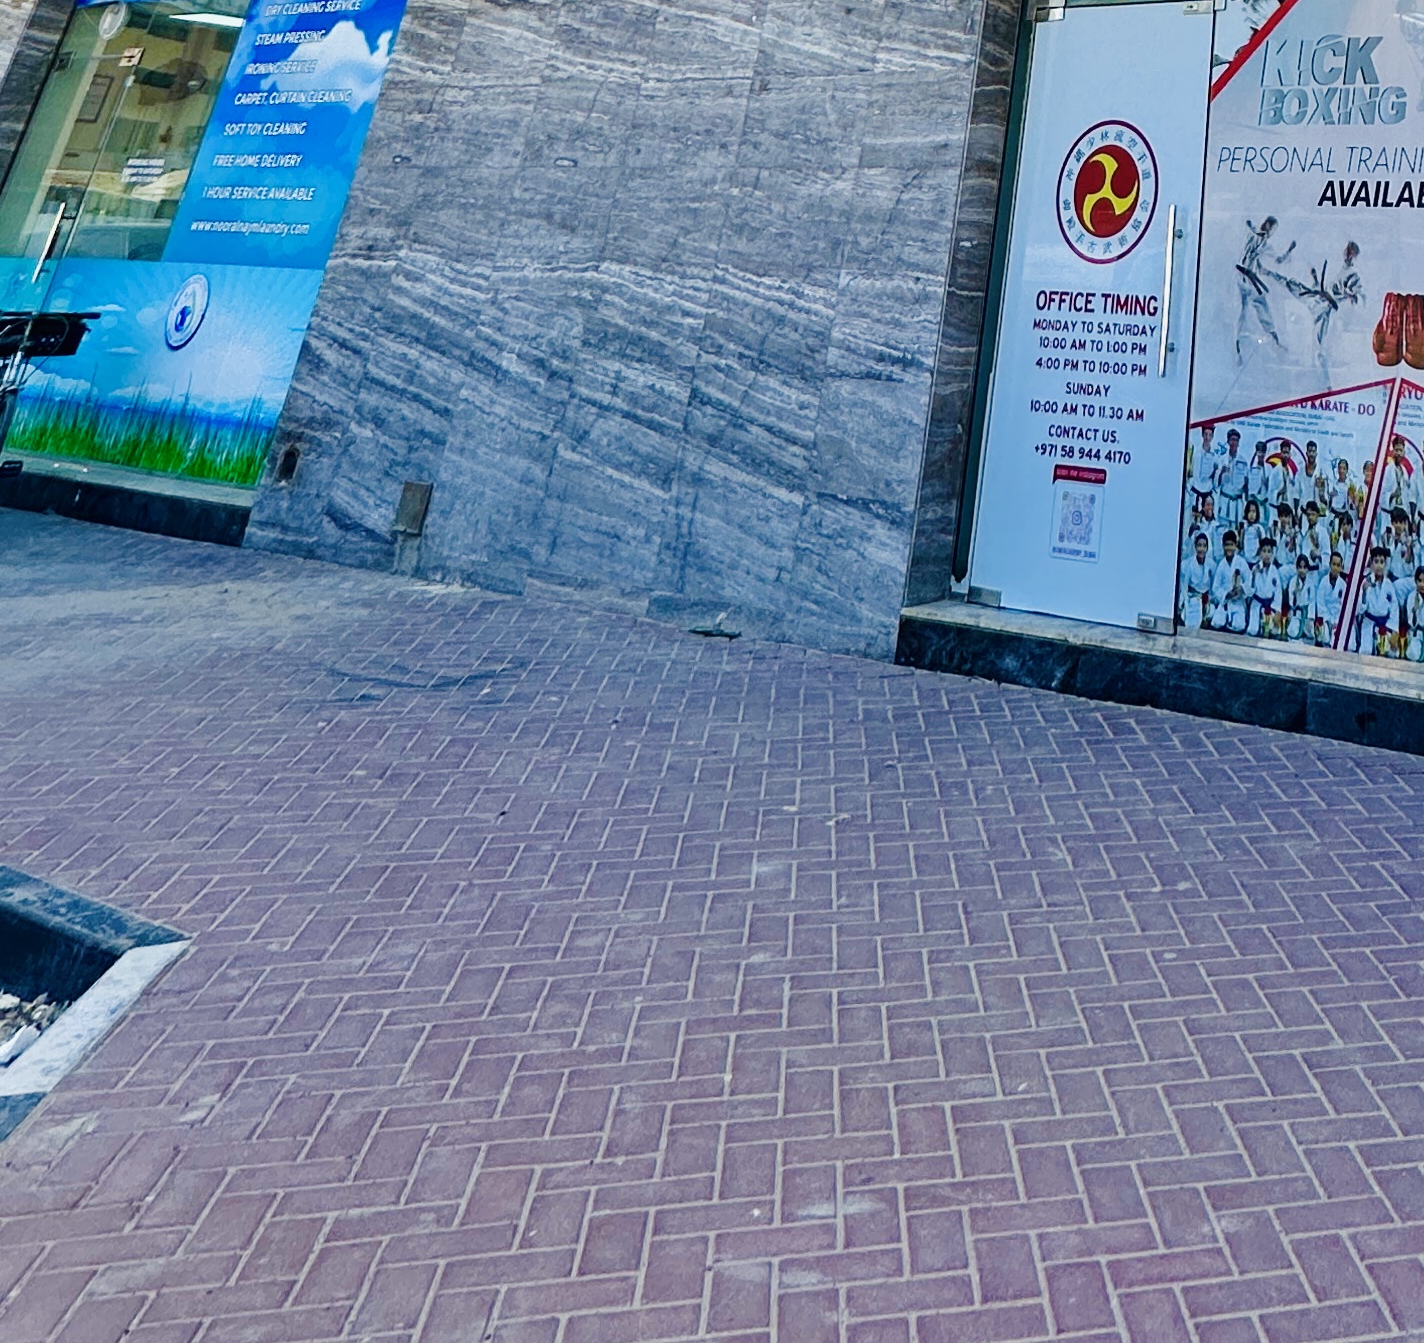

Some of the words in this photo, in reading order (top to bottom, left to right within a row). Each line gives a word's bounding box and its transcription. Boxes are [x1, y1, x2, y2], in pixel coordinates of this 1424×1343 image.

[283, 0, 325, 15] CLEANING
[255, 32, 284, 46] STEAM
[283, 29, 325, 44] PRESSING
[244, 62, 280, 75] IRONING
[1260, 34, 1383, 87] KICK
[269, 90, 307, 105] CURTAIN
[308, 89, 352, 104] CLEANING
[1258, 86, 1408, 126] BOXING
[223, 122, 246, 136] SOFT
[247, 122, 263, 136] TOY
[263, 121, 307, 136] CLEANING
[212, 154, 235, 167] FREE
[235, 153, 261, 167] HOME
[260, 153, 303, 168] DELIVERY
[1217, 145, 1338, 173] PERSONAL
[207, 186, 231, 199] HOUR
[231, 186, 268, 200] SERVICE
[268, 187, 316, 201] AVAILABLE
[1036, 290, 1096, 314] OFFICE
[1101, 293, 1159, 317] TIMING
[1033, 318, 1078, 333] MONDAY
[1081, 320, 1094, 334] TO
[1097, 322, 1157, 337] SATURDAY
[1039, 335, 1067, 350] 10:00
[1070, 338, 1087, 352] AM
[1090, 339, 1103, 353] TO
[1131, 342, 1147, 356] PM
[1035, 357, 1061, 370] 4:00
[1063, 359, 1079, 372] PM
[1083, 360, 1096, 373] TO
[1099, 361, 1128, 376] 10:00
[1131, 363, 1147, 378] PM
[1065, 382, 1111, 398] SUNDAY
[1030, 399, 1058, 414] 10:00
[1062, 402, 1078, 416] AM
[1082, 404, 1095, 417] TO
[1126, 408, 1144, 422] AM
[1310, 398, 1349, 414] KARATE
[1357, 403, 1376, 416] DO
[1048, 424, 1099, 442] CONTACT
[1035, 443, 1058, 458] +971
[1060, 445, 1075, 459] 58
[1078, 447, 1101, 461] 944
[1105, 449, 1131, 465] 4170
